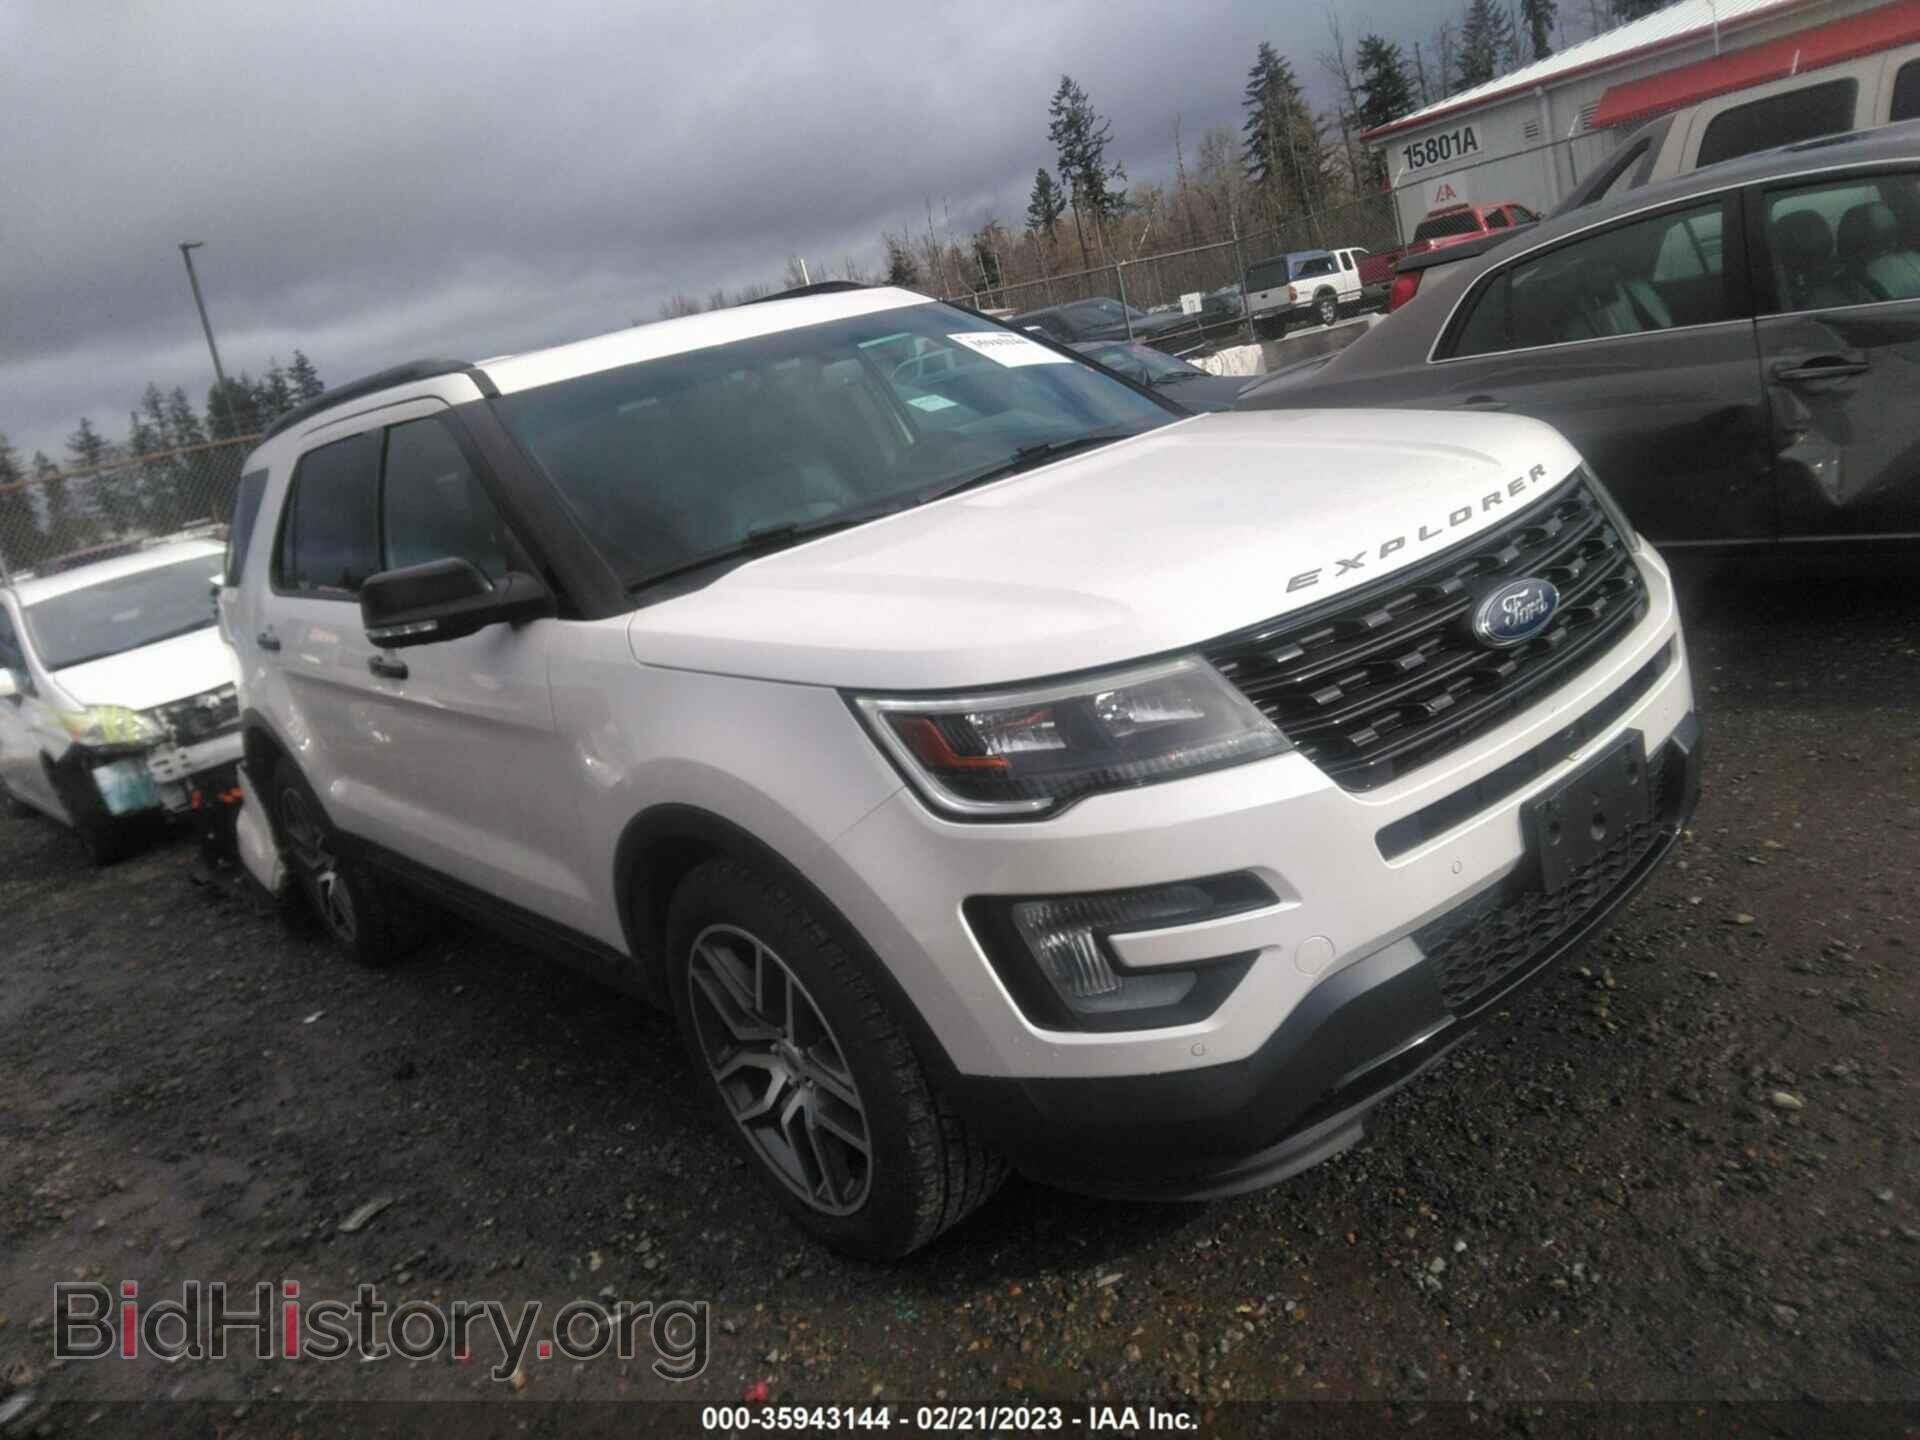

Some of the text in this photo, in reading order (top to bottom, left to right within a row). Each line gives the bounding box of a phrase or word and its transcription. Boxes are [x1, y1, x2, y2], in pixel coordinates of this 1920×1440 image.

[1403, 126, 1478, 170] 15801A
[1286, 463, 1546, 593] EXPLORER
[1502, 588, 1548, 625] Ford
